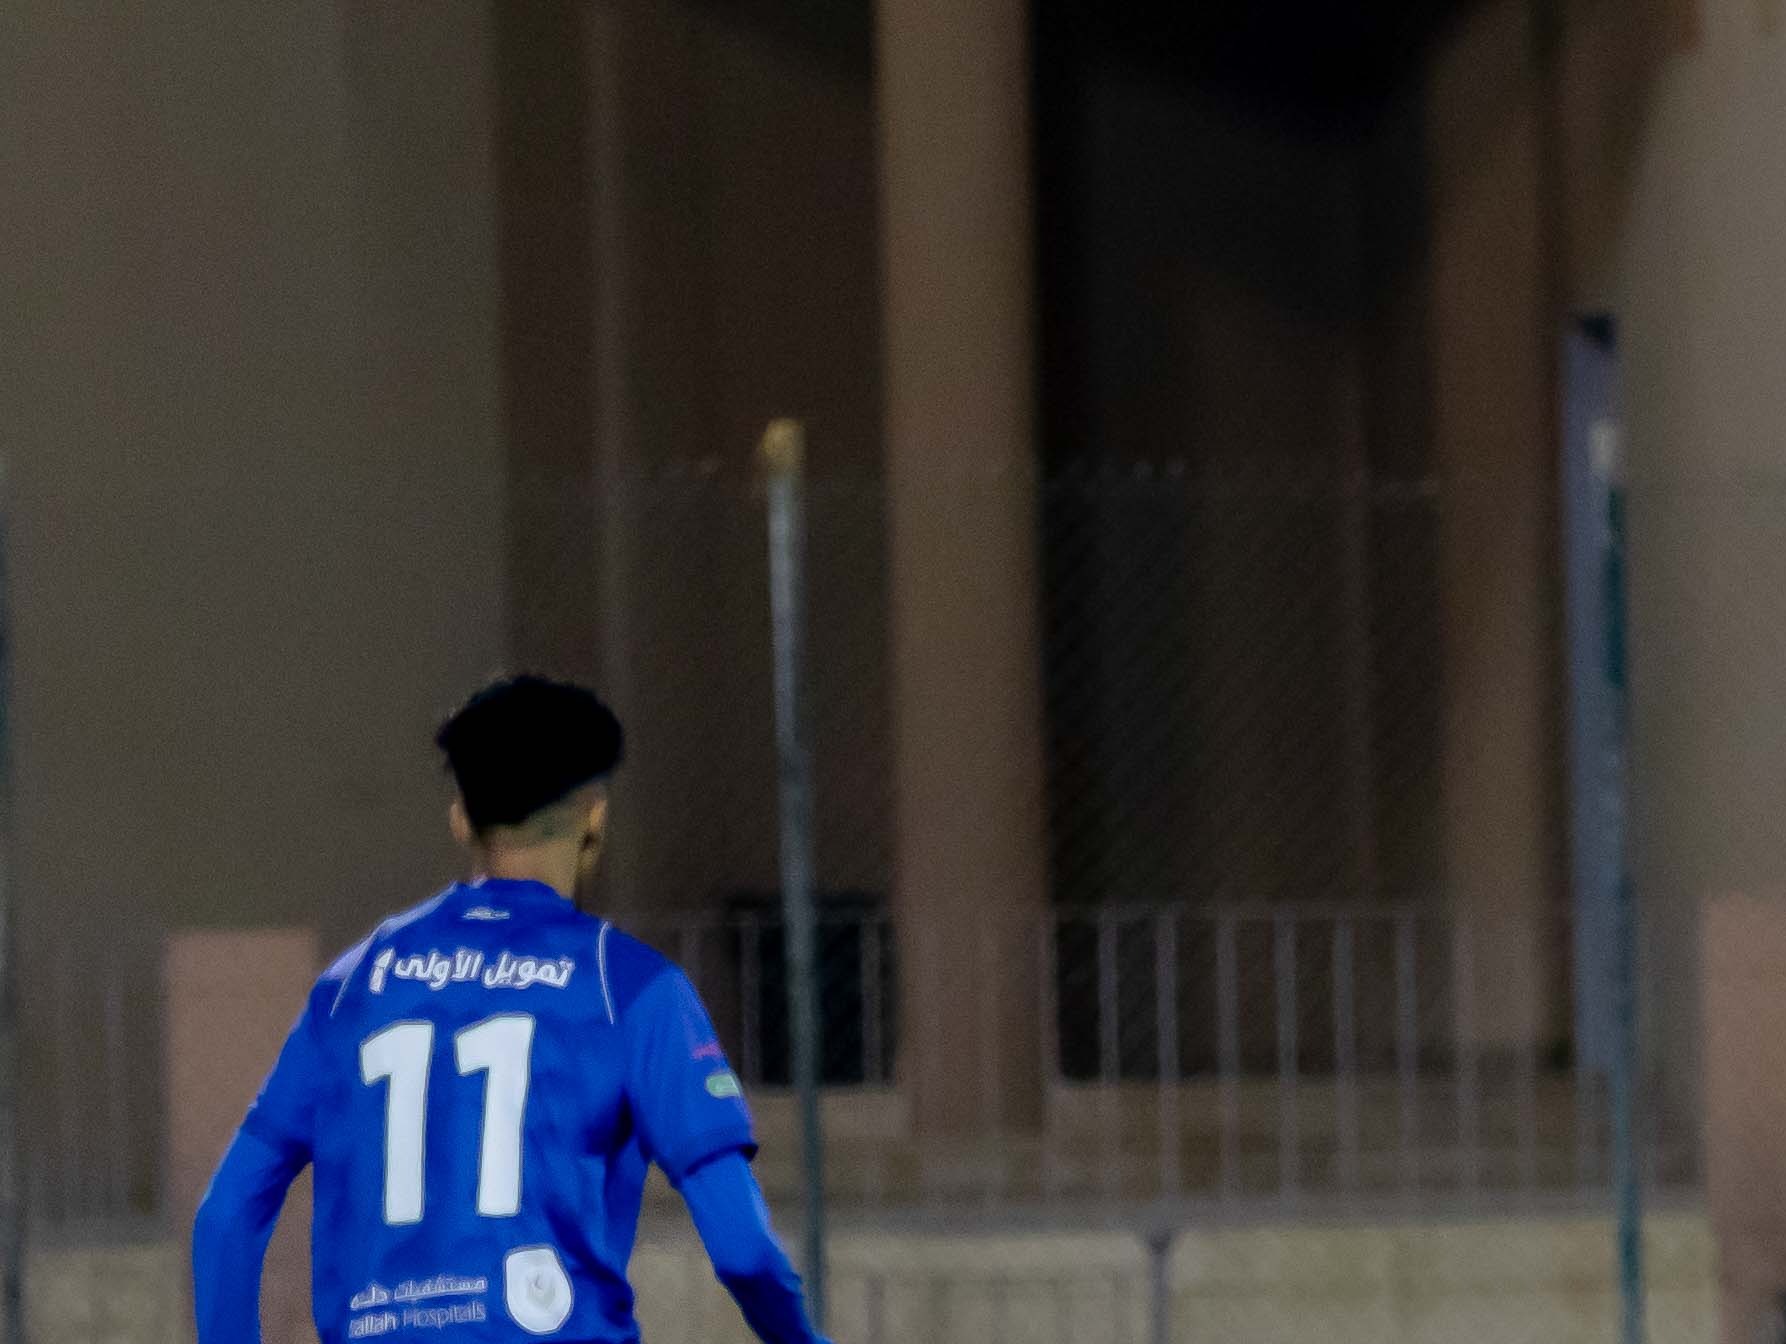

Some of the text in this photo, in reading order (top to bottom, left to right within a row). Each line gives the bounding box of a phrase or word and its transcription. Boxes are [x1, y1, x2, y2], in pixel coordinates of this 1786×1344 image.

[485, 952, 574, 987] تمويل
[360, 1014, 534, 1225] 11
[403, 1301, 486, 1327] Hospitals
